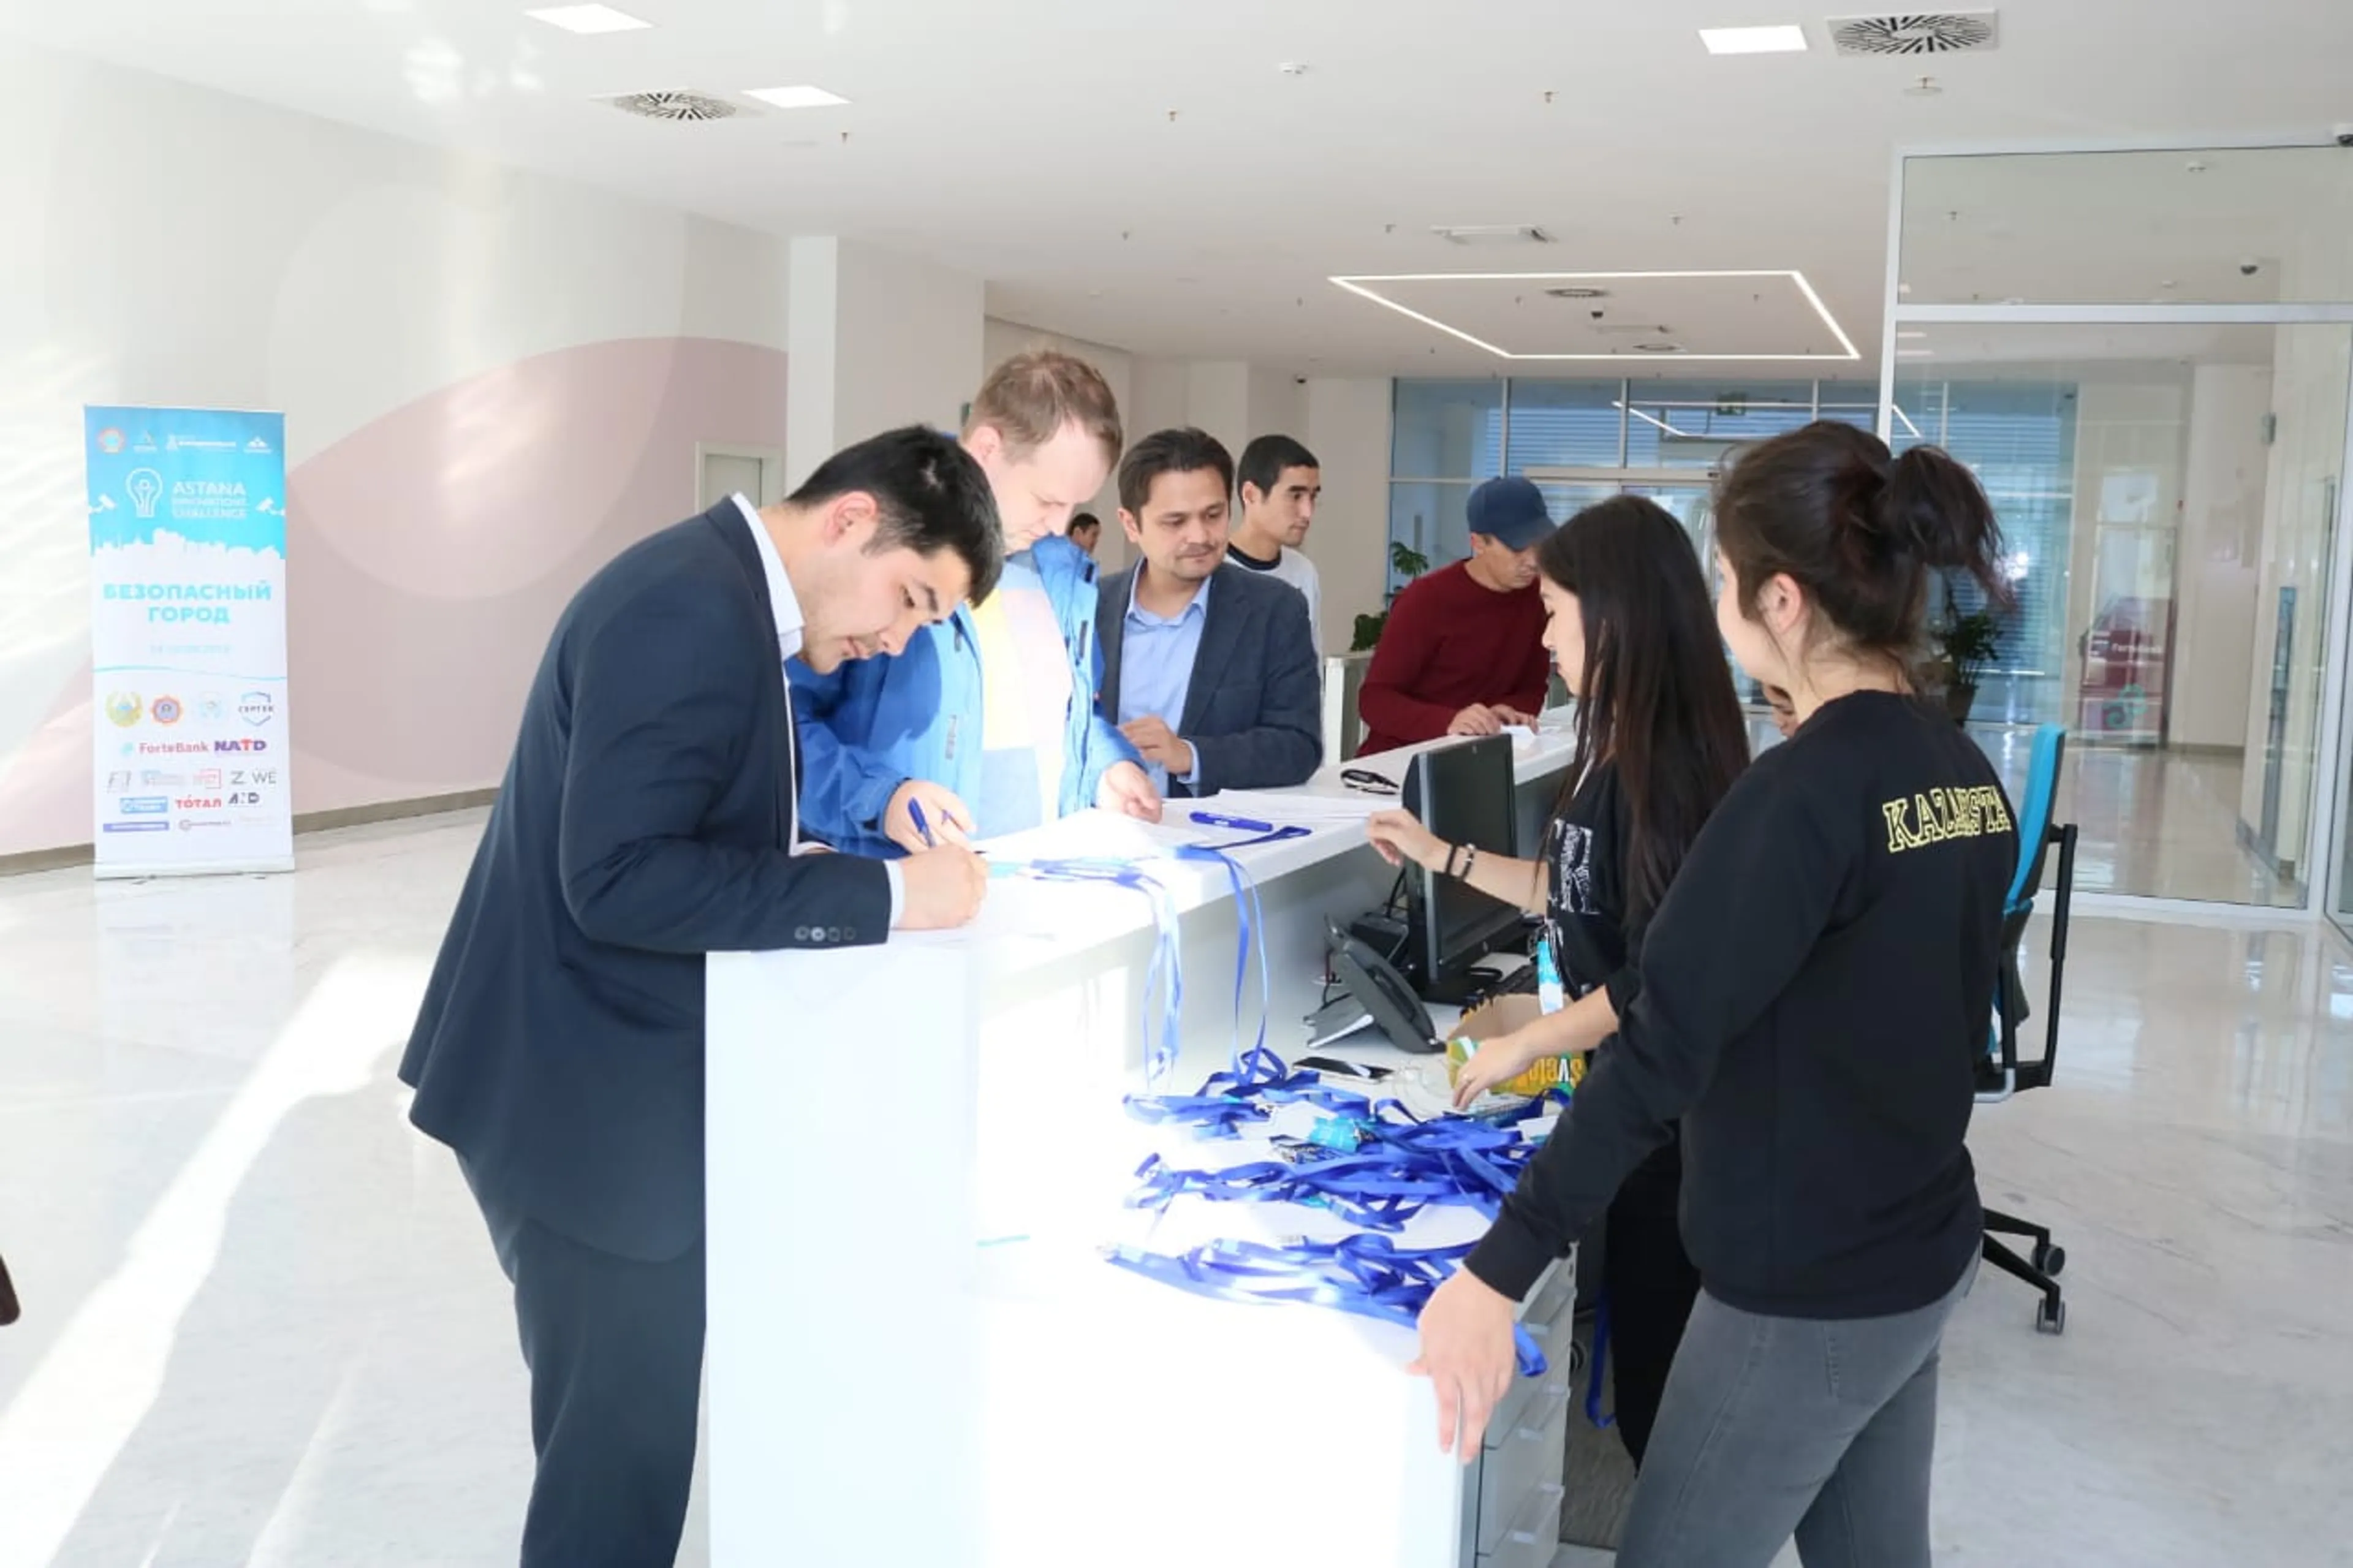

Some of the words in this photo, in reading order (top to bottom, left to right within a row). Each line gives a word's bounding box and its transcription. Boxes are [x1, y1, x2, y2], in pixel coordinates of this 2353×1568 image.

[173, 481, 247, 496] ASTANA
[103, 580, 272, 600] БЕЗОПАСНЫЙ
[148, 606, 230, 624] ГОРОД
[138, 741, 209, 754] ForteBank
